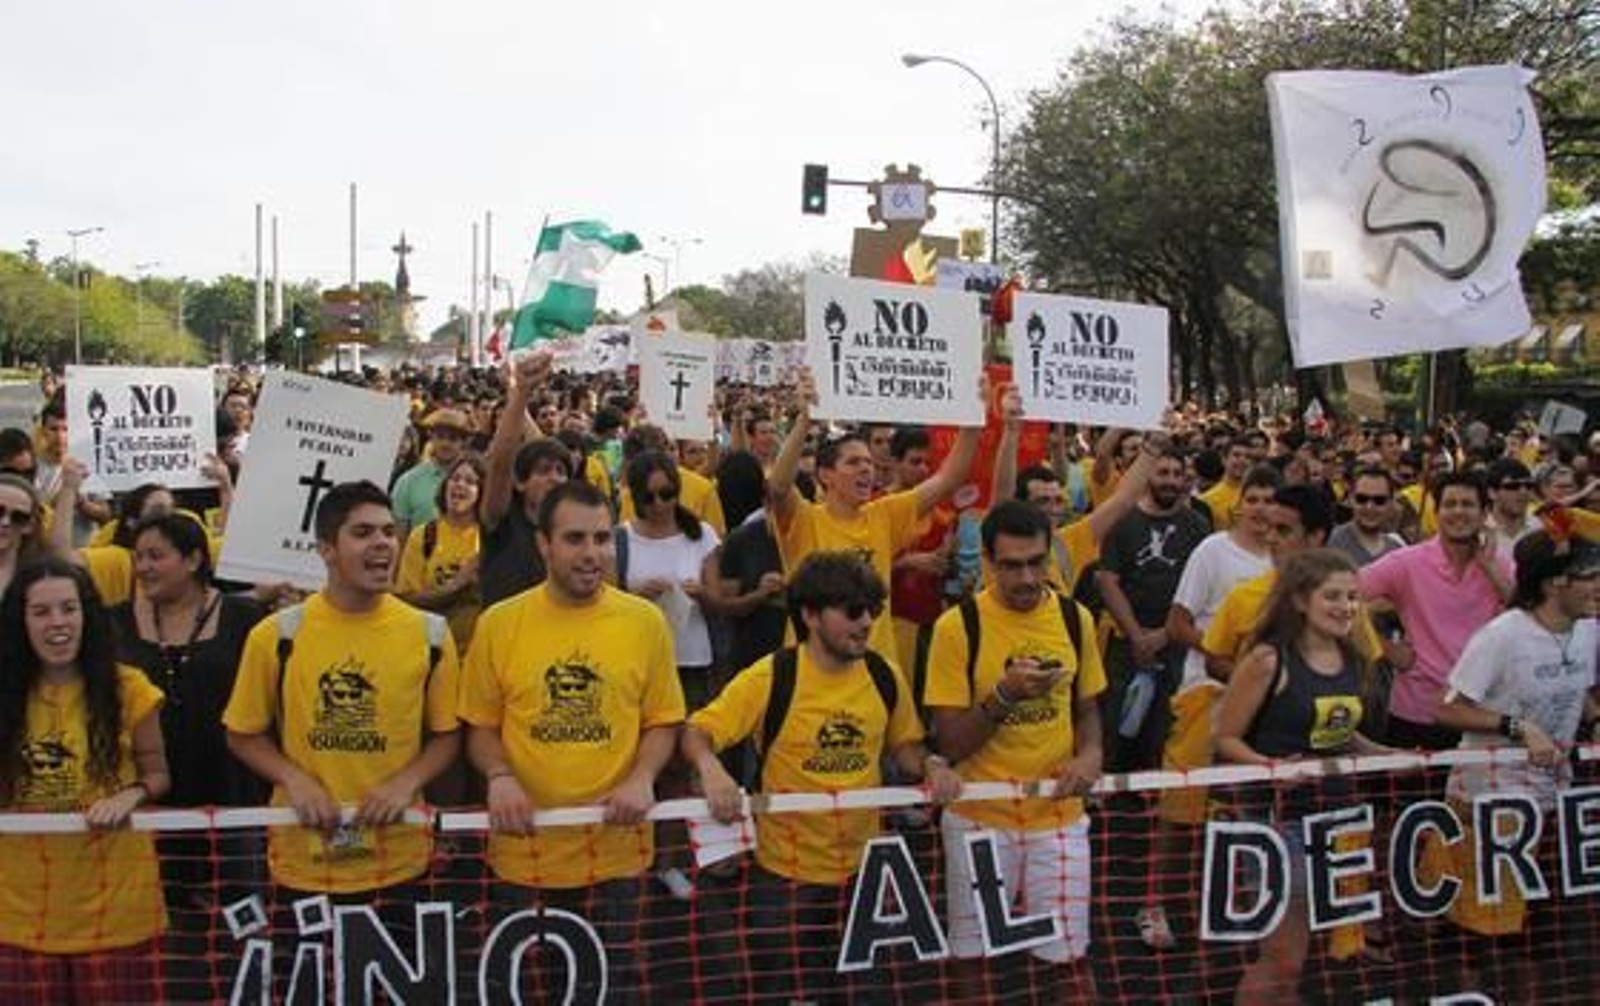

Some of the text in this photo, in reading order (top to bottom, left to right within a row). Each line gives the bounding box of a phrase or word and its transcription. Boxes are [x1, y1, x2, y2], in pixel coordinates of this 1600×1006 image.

[873, 299, 928, 336] NO
[1070, 310, 1119, 345] NO
[853, 332, 947, 352] AL DECRETO
[1051, 341, 1134, 361] AL DECRETO
[861, 361, 946, 378] UNIVERSIDAD
[129, 384, 177, 415] NO
[112, 415, 192, 429] AL DECRETO
[286, 417, 373, 443] UNIVERSIDAD
[836, 835, 1060, 973] AL
[1200, 785, 1600, 942] DECRE
